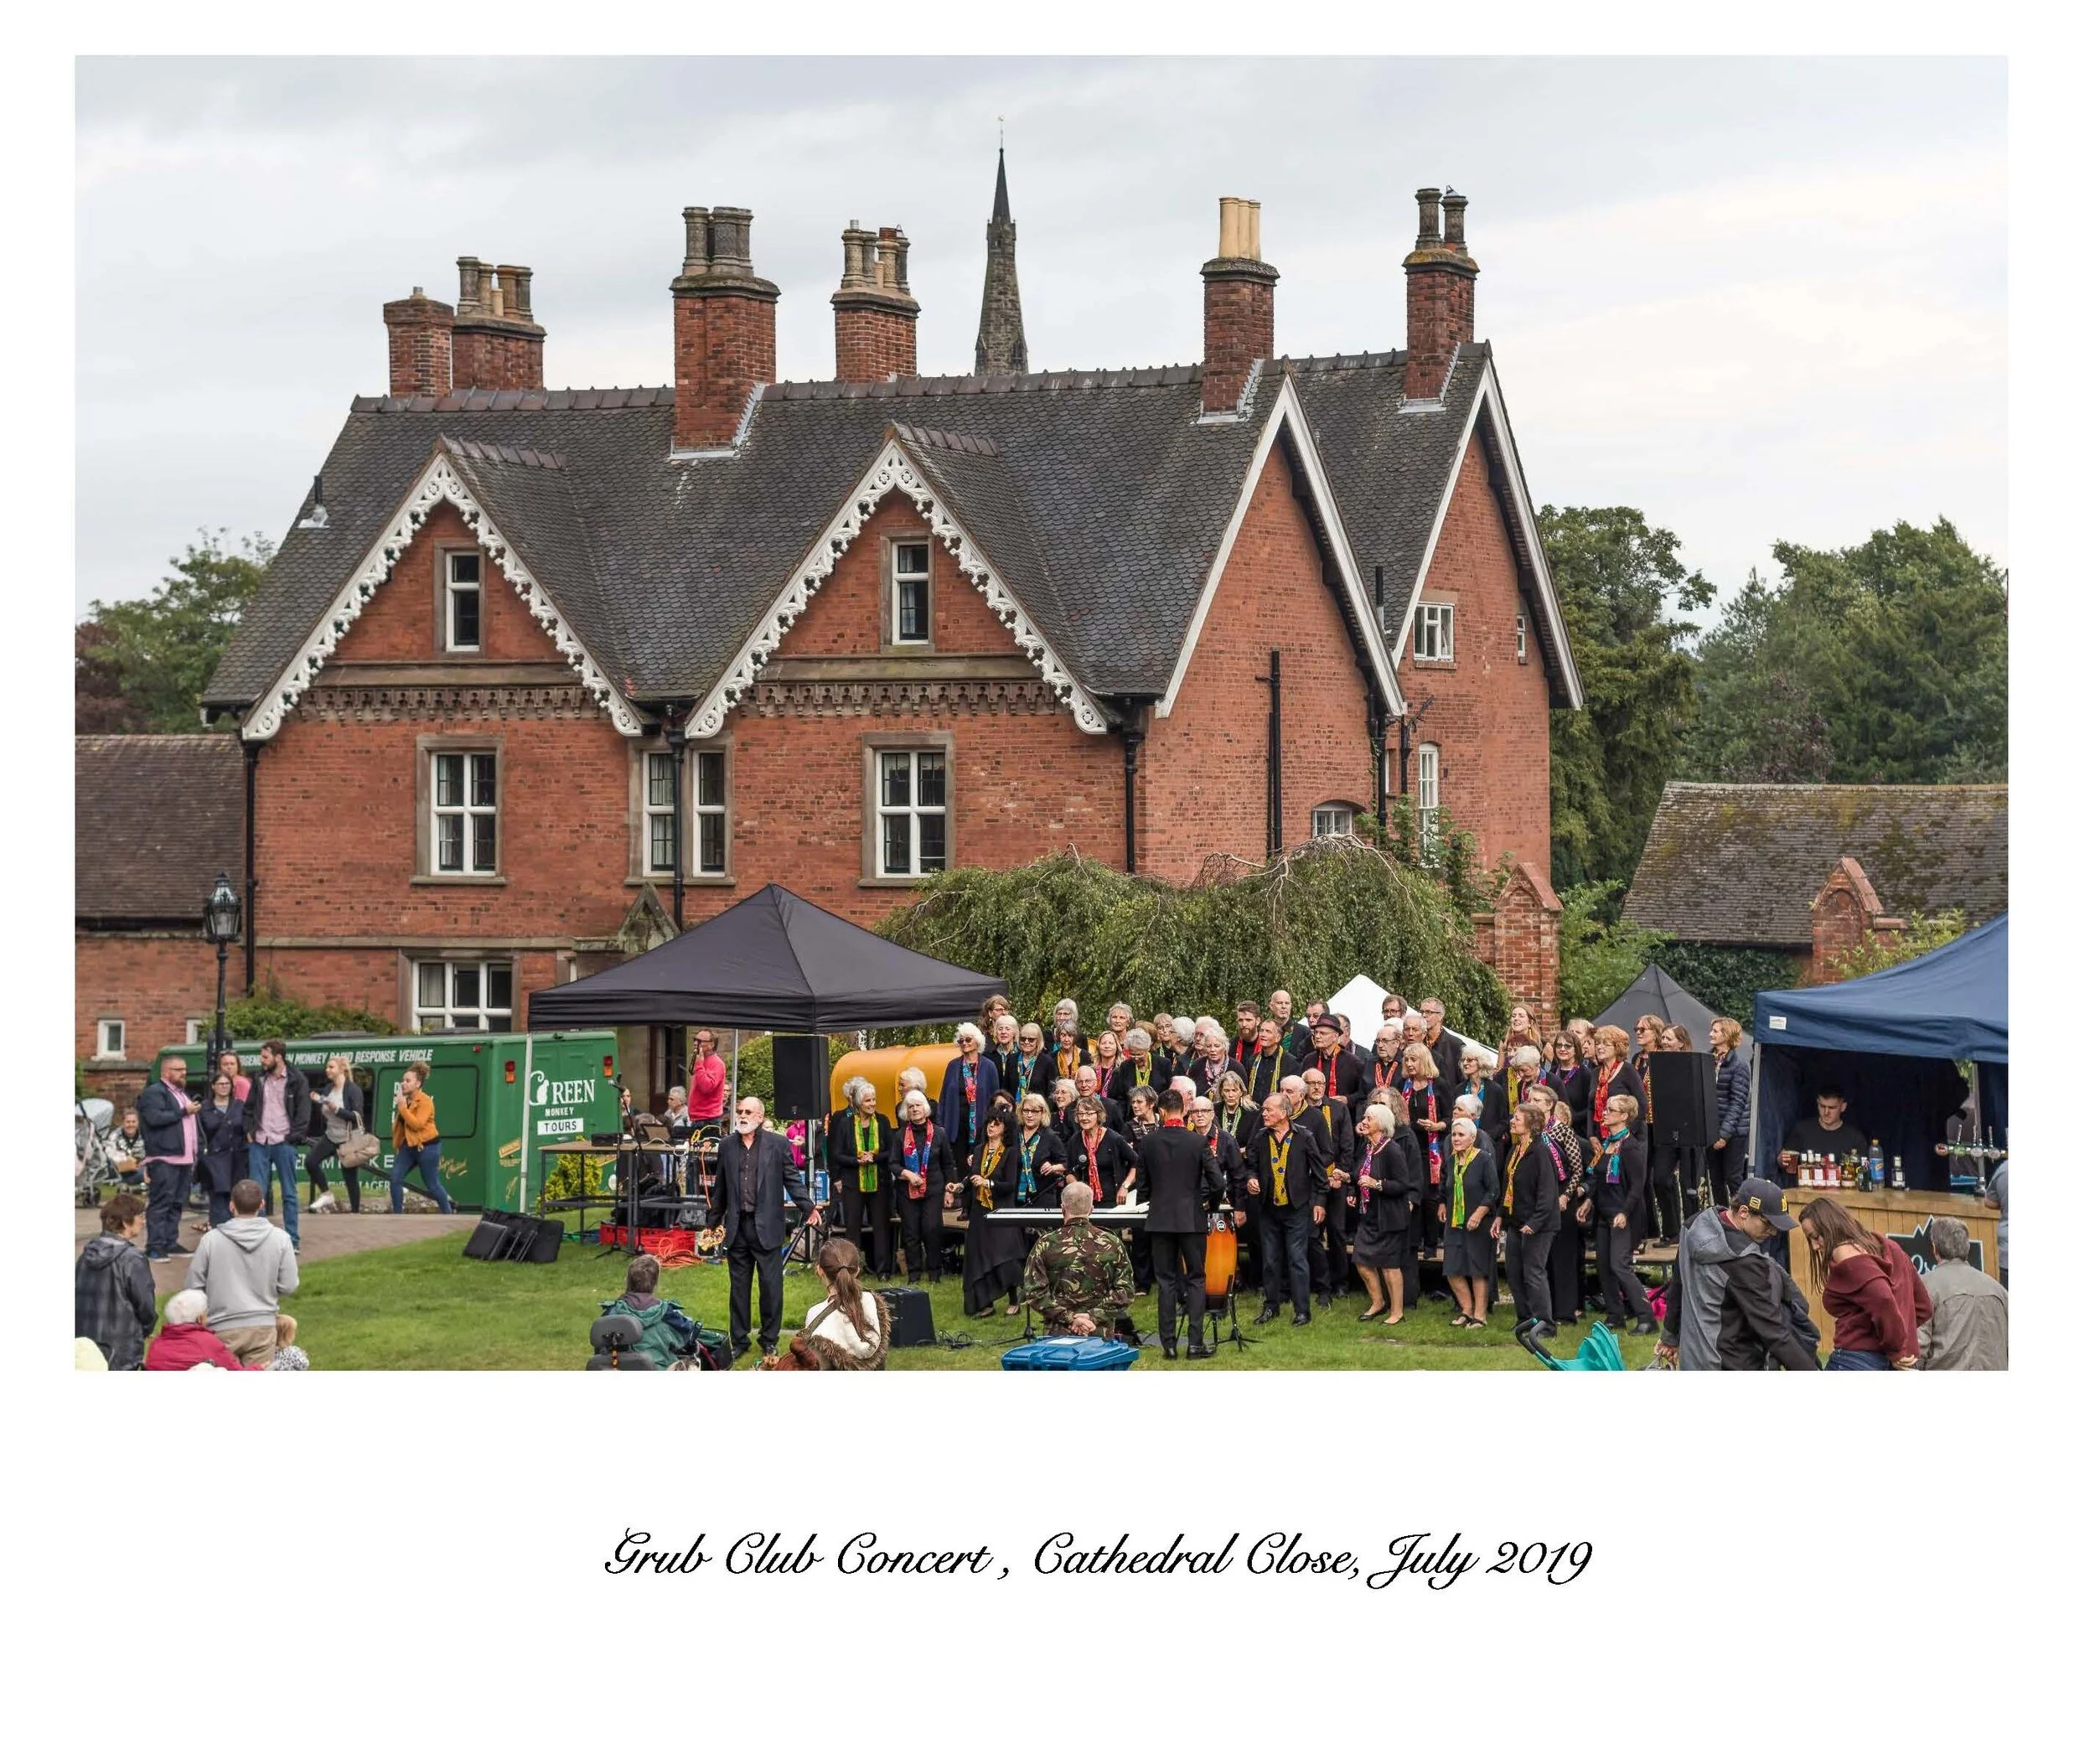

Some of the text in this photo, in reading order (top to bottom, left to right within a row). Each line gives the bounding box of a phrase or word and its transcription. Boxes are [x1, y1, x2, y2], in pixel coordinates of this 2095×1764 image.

[294, 1051, 328, 1064] MONKEY
[354, 1049, 396, 1063] RESPONSE
[398, 1048, 433, 1062] VEHICLE
[529, 1069, 596, 1106] GREEN
[545, 1106, 575, 1117] MONKEY
[544, 1120, 577, 1132] TOURS
